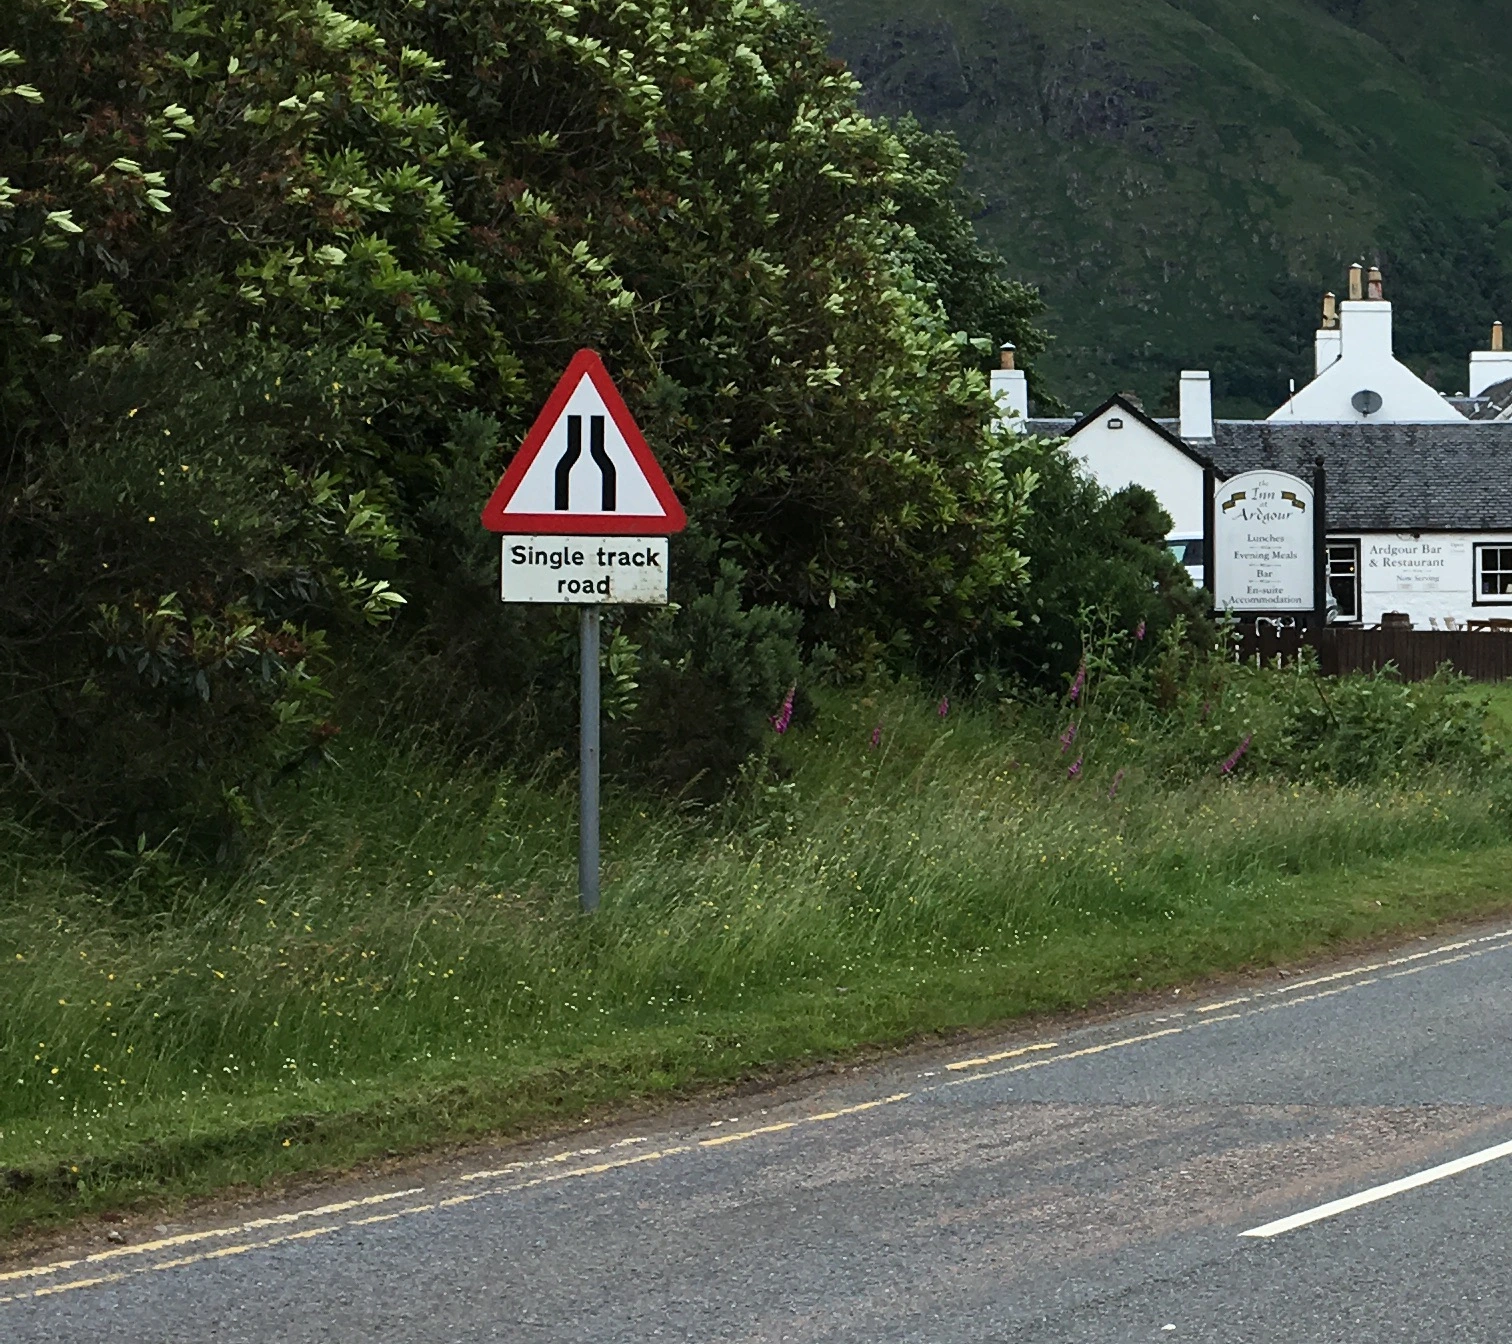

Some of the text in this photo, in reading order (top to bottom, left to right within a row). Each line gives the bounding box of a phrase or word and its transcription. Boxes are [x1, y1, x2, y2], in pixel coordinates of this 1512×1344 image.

[1251, 487, 1275, 500] Inn
[1232, 508, 1293, 525] Ardgour
[1247, 534, 1285, 543] Lunches
[1370, 544, 1418, 556] Ardgour
[1422, 544, 1442, 554] Bar
[511, 545, 660, 569] Single track
[1234, 551, 1297, 560] Evening Meals
[1369, 557, 1444, 567] & Restaurant
[1256, 569, 1273, 578] Bar
[557, 575, 610, 595] road
[1246, 586, 1284, 594] En-suite
[1229, 595, 1302, 604] Accommodation
